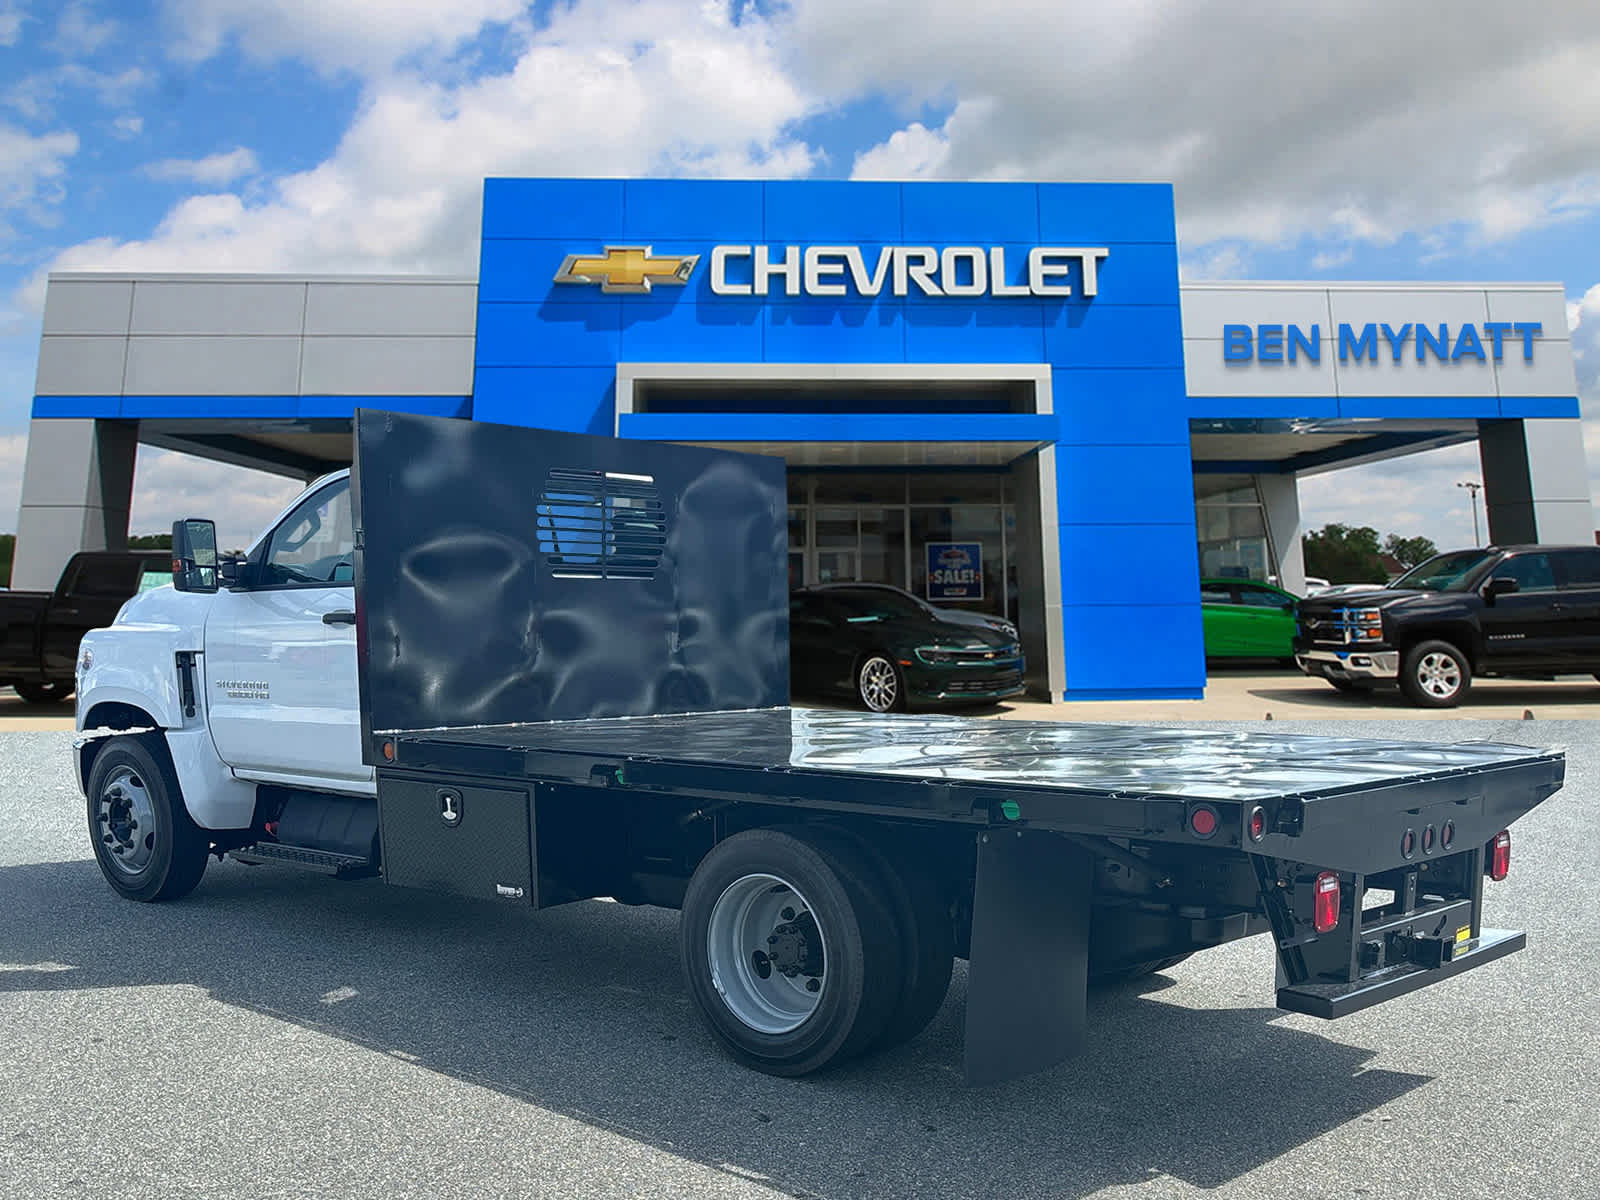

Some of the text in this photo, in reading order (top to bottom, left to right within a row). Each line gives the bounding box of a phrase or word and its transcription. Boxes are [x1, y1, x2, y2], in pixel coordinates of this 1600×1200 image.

[710, 245, 1110, 297] CHEVROLET
[1223, 322, 1543, 362] BEN MYNATT
[934, 569, 975, 585] SALE!
